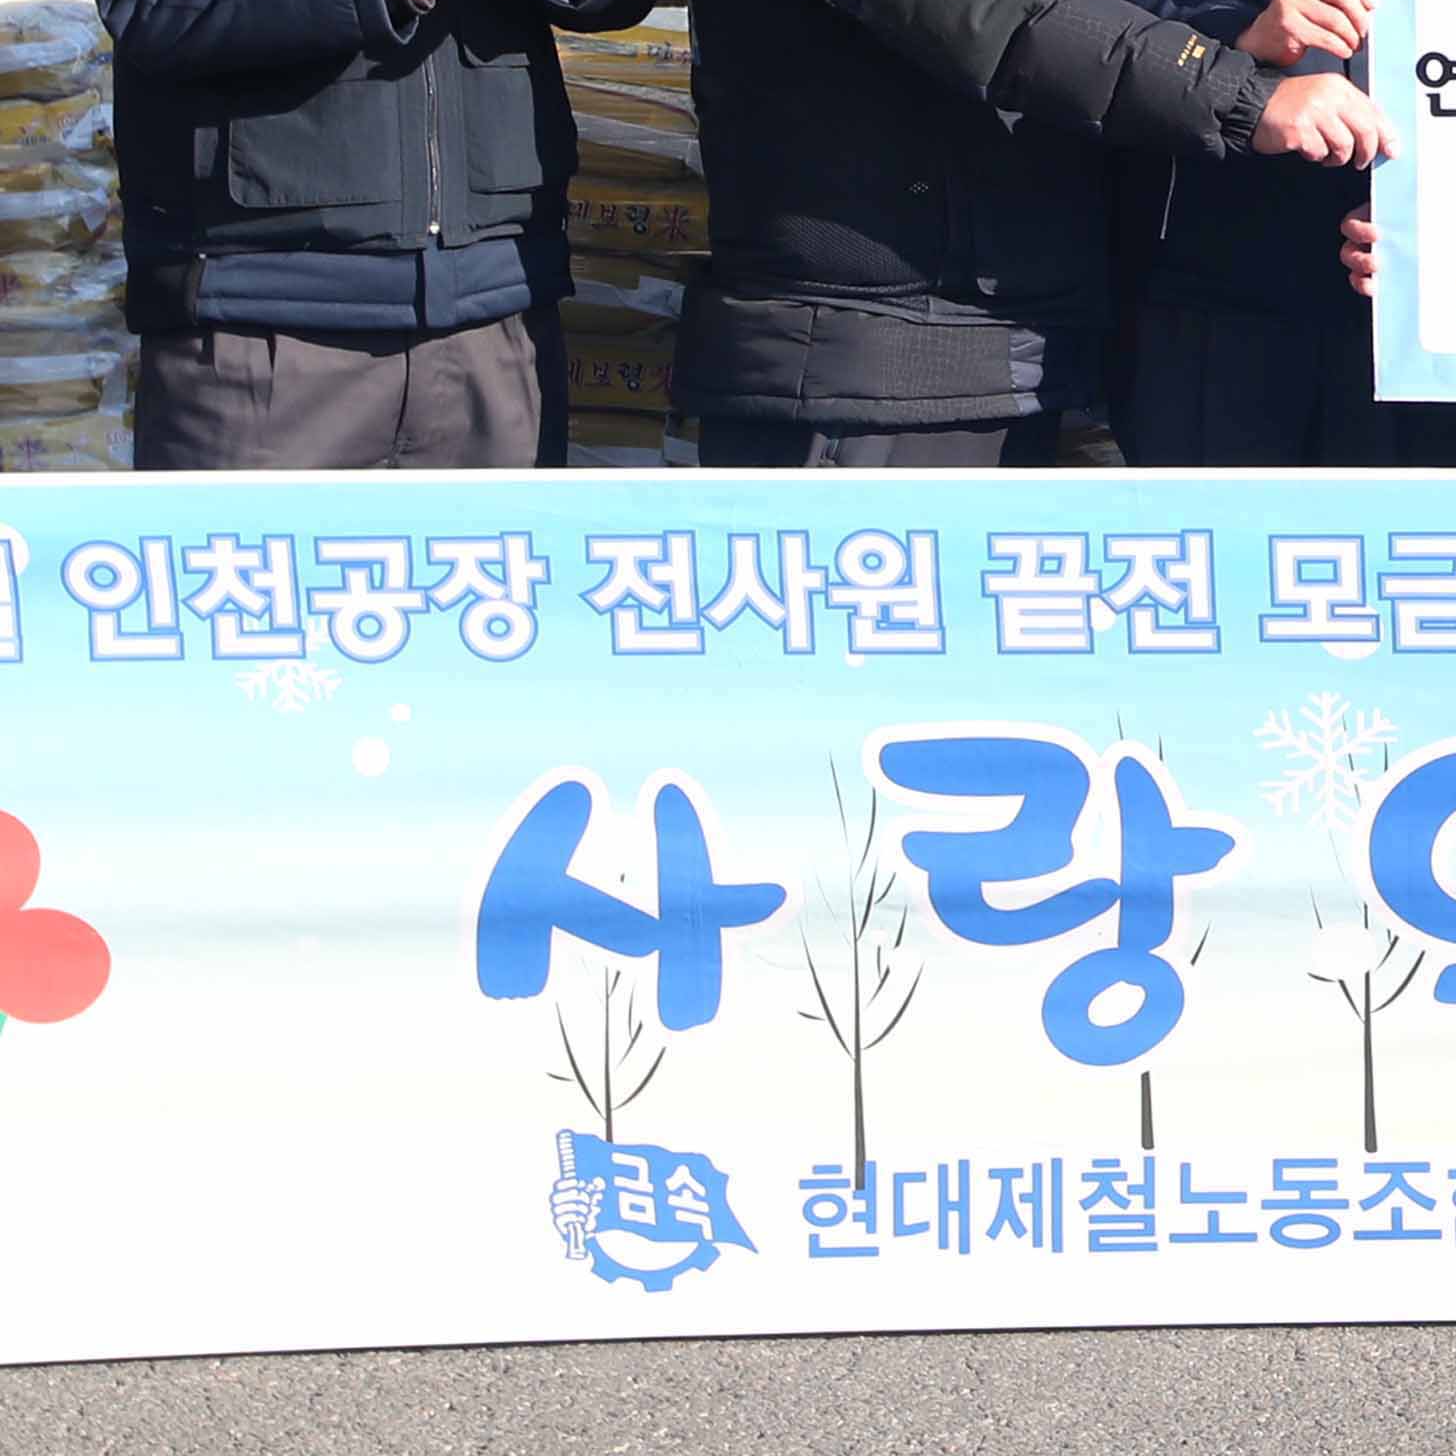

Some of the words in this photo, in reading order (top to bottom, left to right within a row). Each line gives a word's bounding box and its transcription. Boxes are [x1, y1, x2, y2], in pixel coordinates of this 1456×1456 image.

[60, 531, 551, 663] 인천공장
[579, 529, 947, 655] 전사원
[981, 529, 1222, 655] 끝전
[611, 1151, 714, 1241] 금속
